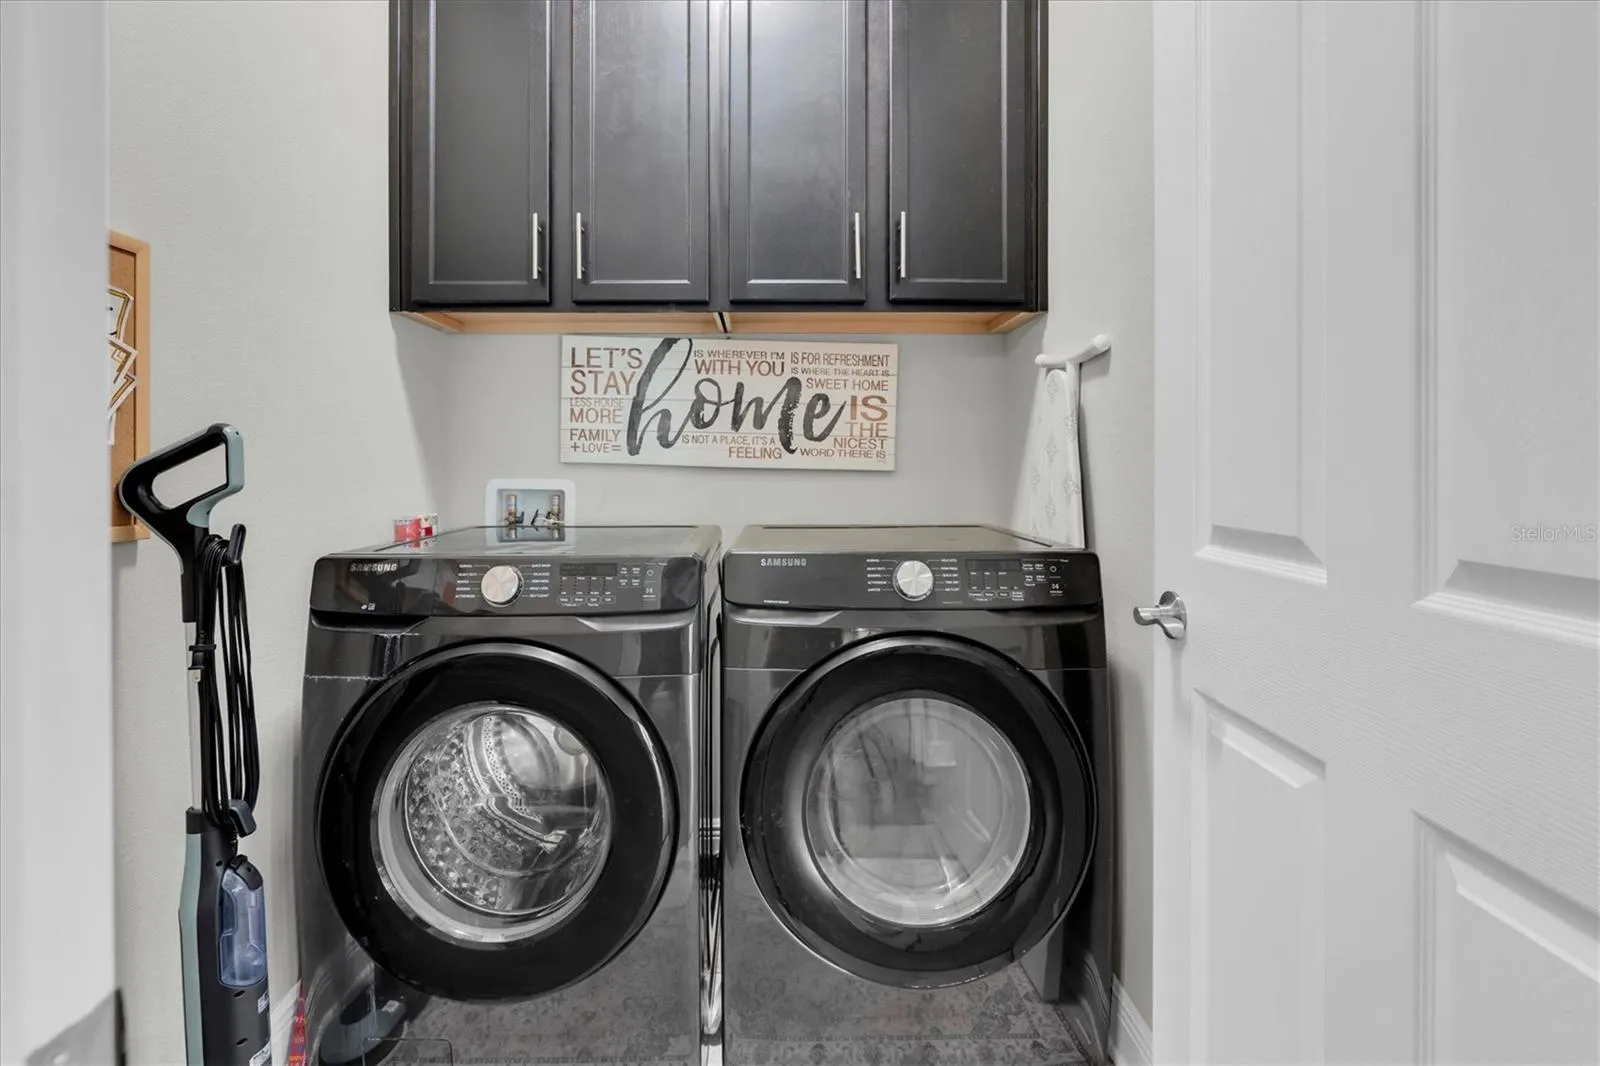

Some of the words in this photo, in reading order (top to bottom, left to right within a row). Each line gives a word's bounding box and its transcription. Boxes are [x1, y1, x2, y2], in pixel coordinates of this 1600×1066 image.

[694, 349, 704, 358] IS
[707, 350, 768, 360] WHEREVER
[770, 352, 785, 360] I'M
[791, 352, 799, 364] IS
[801, 352, 821, 364] FOR
[823, 353, 890, 367] REFRESHMENT
[694, 359, 741, 375] WITH
[746, 360, 785, 377] YOU
[791, 367, 799, 375] IS
[801, 368, 830, 376] WHERE
[834, 368, 849, 377] THE
[852, 369, 879, 377] HEART
[570, 369, 636, 396] STAY
[806, 377, 849, 390] SWEET
[852, 379, 889, 391] HOME
[570, 397, 592, 408] LESS
[594, 397, 625, 408] HOUSE
[627, 338, 846, 457] home
[570, 407, 623, 424] MORE
[850, 395, 888, 422] IS
[570, 428, 621, 442] FAMILY
[845, 421, 889, 438] THE
[682, 434, 690, 444] IS
[691, 435, 710, 445] NOT
[711, 435, 718, 445] A
[769, 437, 776, 446] A
[833, 437, 886, 450] NICEST
[728, 446, 782, 460] FEELING
[800, 448, 835, 457] WORD
[837, 449, 873, 459] THERE
[876, 449, 887, 459] IS
[350, 563, 398, 572] SAMSUNG
[760, 558, 807, 567] SAMSUNG
